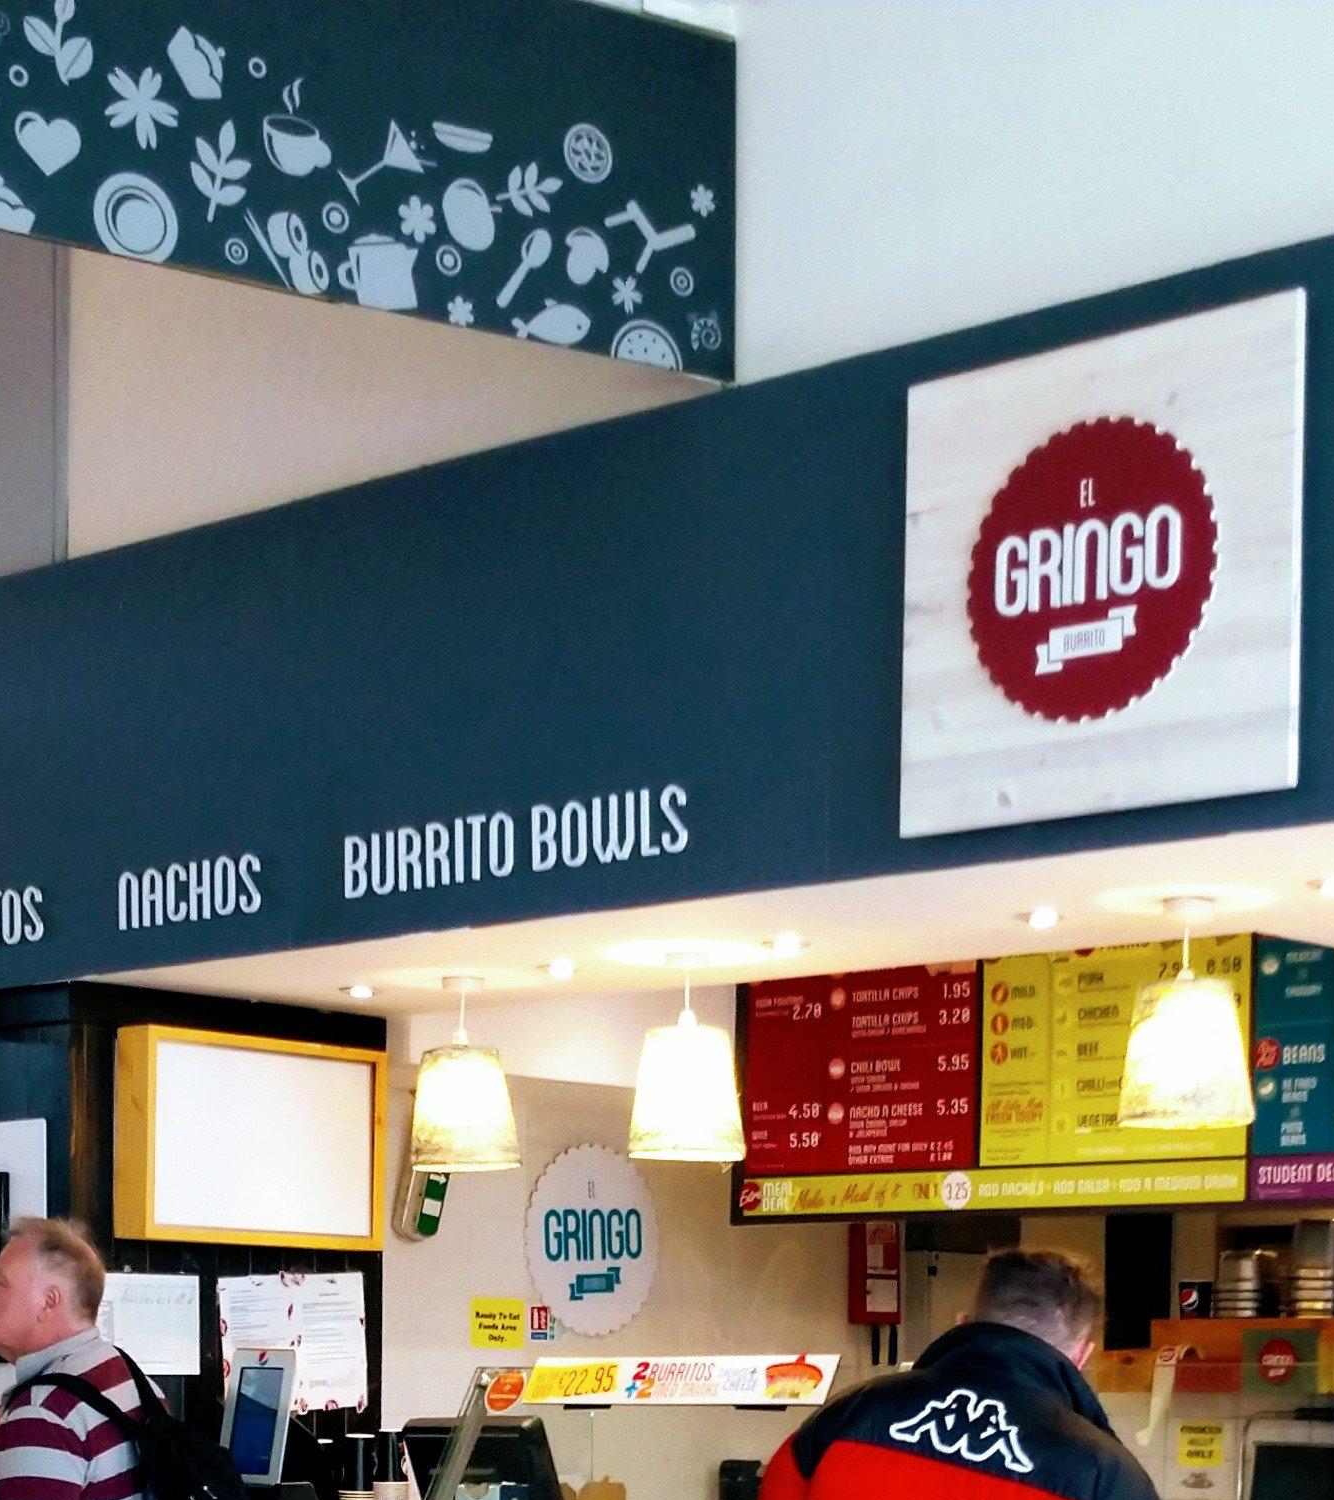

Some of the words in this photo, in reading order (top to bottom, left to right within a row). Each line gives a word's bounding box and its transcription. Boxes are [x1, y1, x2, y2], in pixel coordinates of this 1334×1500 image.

[1080, 478, 1096, 508] EL
[994, 503, 1183, 617] GRINGO
[344, 812, 514, 900] BURRITO
[532, 784, 689, 873] BOWLS
[118, 854, 261, 931] NACHOS
[852, 988, 889, 1002] TORTILLA
[892, 986, 919, 1000] CHIPS
[943, 981, 970, 999] 1.95
[793, 1003, 821, 1020] 2.70
[852, 1013, 890, 1028] TORTILLA
[892, 1011, 919, 1025] CHIPS
[938, 1007, 970, 1026] 3.20
[938, 1053, 970, 1072] 5.95
[1282, 1043, 1326, 1065] BEANS
[789, 1103, 820, 1119] 4.50
[850, 1105, 880, 1119] NACHO
[891, 1103, 924, 1117] CHEESE
[936, 1097, 969, 1115] 5.35
[789, 1131, 819, 1148] 5.50
[1257, 1164, 1313, 1185] STUDENT
[945, 1181, 969, 1200] 3.25
[544, 1208, 642, 1262] GRINGO
[633, 1362, 650, 1381] 2
[649, 1362, 715, 1382] BURRITOS
